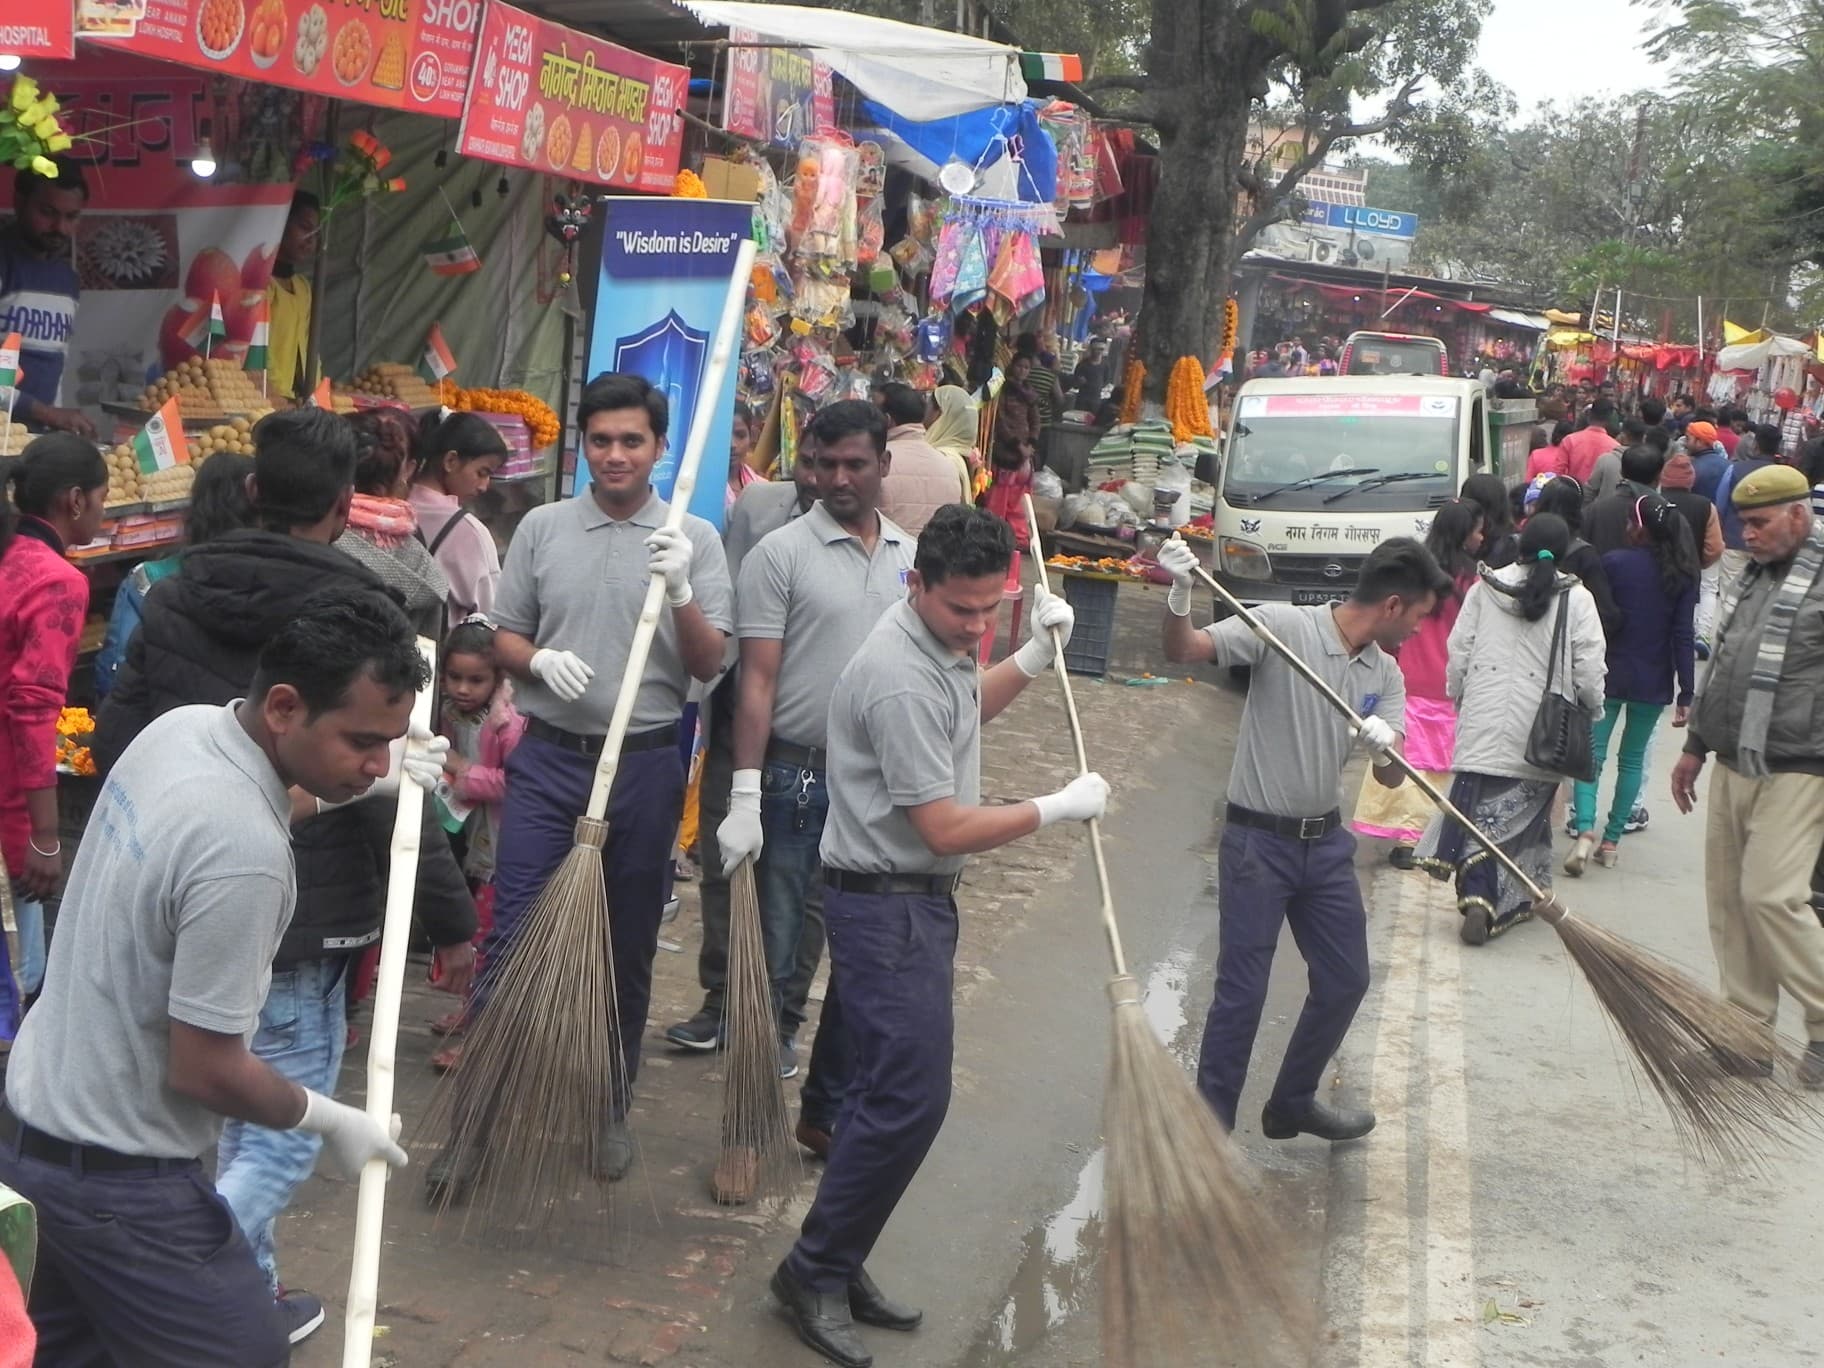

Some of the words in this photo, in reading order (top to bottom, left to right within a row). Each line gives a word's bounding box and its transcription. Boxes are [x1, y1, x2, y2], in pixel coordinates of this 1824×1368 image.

[0, 25, 51, 47] HOSPITAL
[503, 23, 533, 67] MEGA
[495, 65, 529, 111] SHOP
[540, 41, 581, 111] नागेन्द्र
[616, 77, 650, 124] भण्डार
[651, 74, 675, 109] MEGA
[646, 109, 673, 147] SHOP
[1344, 203, 1401, 230] LLOYD
[679, 231, 692, 253] is
[0, 305, 74, 343] JORDAN
[1286, 526, 1307, 540] नगर
[1310, 524, 1339, 541] निगम
